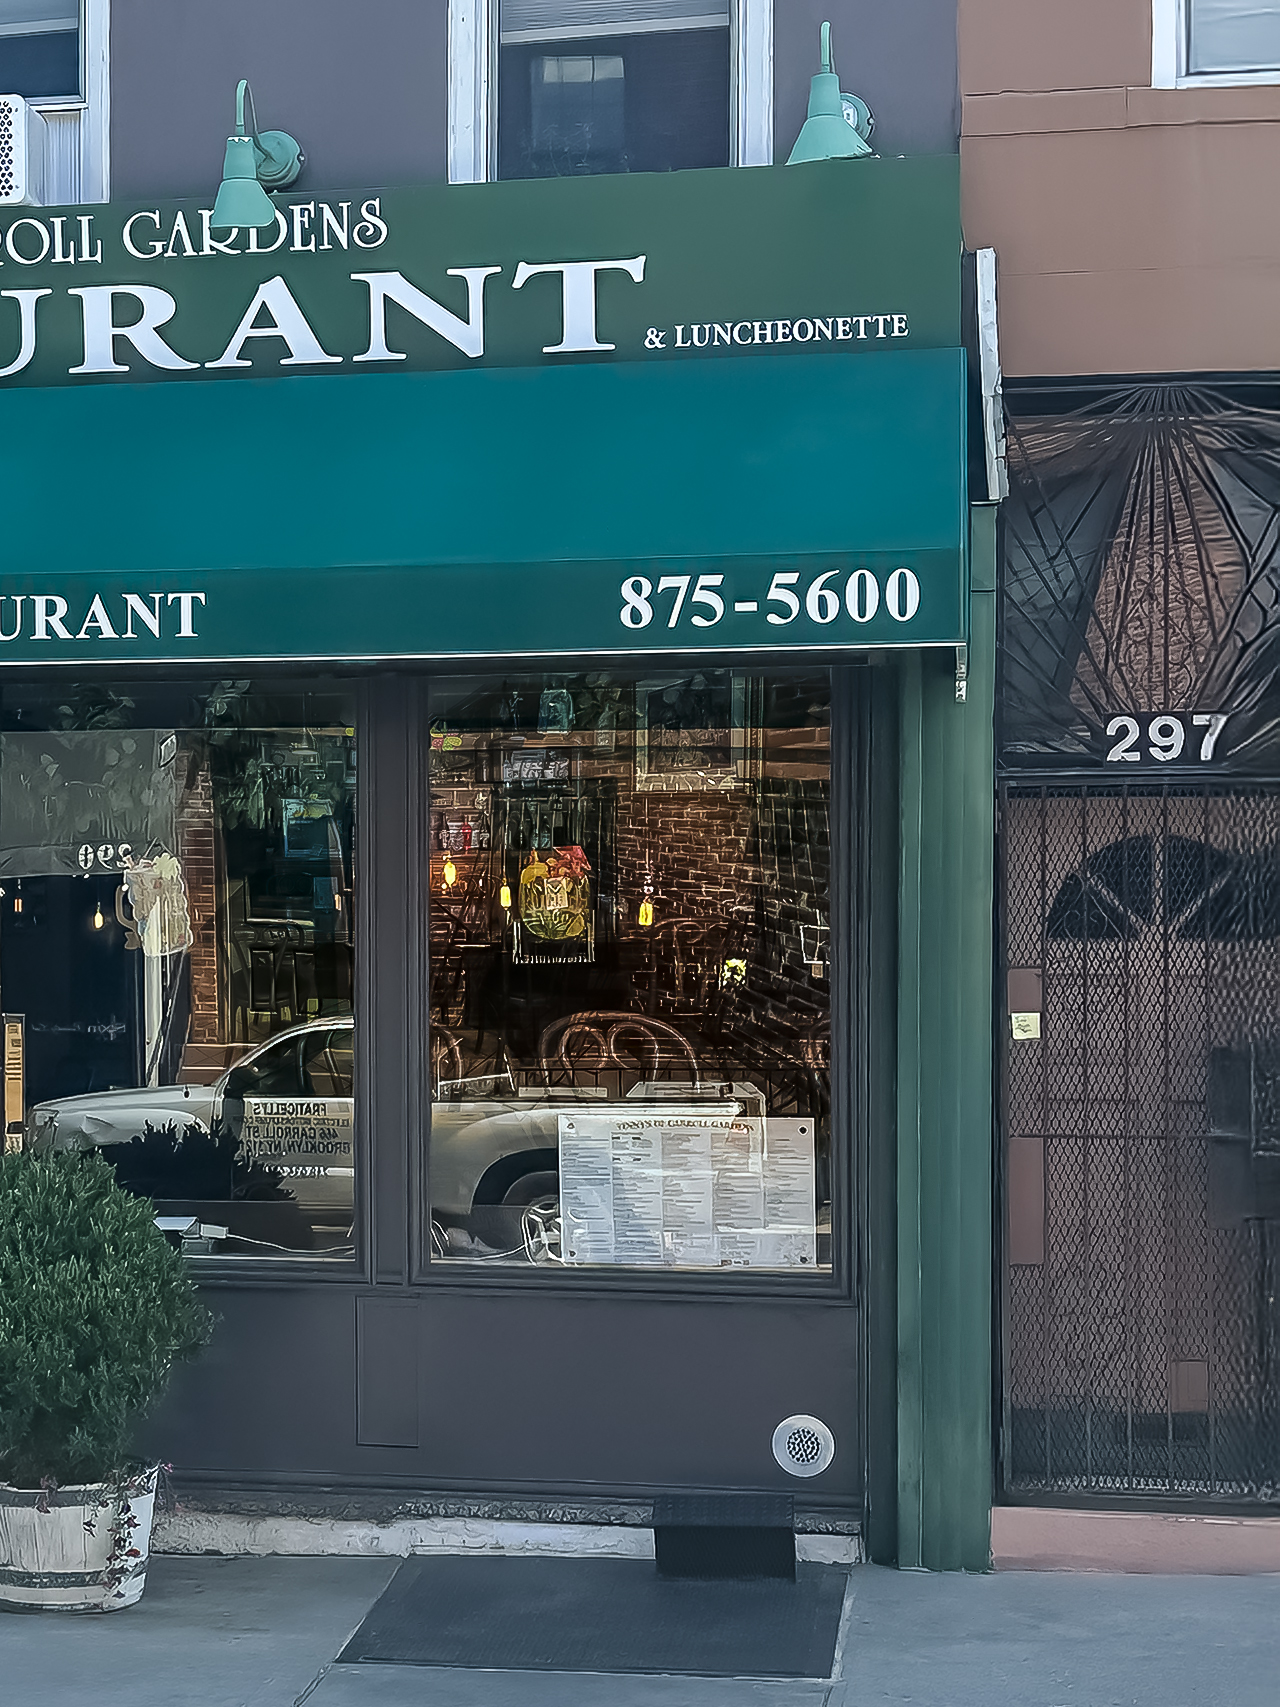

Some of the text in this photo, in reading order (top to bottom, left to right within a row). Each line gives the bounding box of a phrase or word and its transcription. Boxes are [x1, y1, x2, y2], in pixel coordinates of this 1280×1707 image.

[122, 197, 389, 259] GARDENS
[642, 312, 910, 350] & LUNCHEONETTE
[619, 567, 921, 629] 875-5600
[1105, 713, 1228, 762] 297
